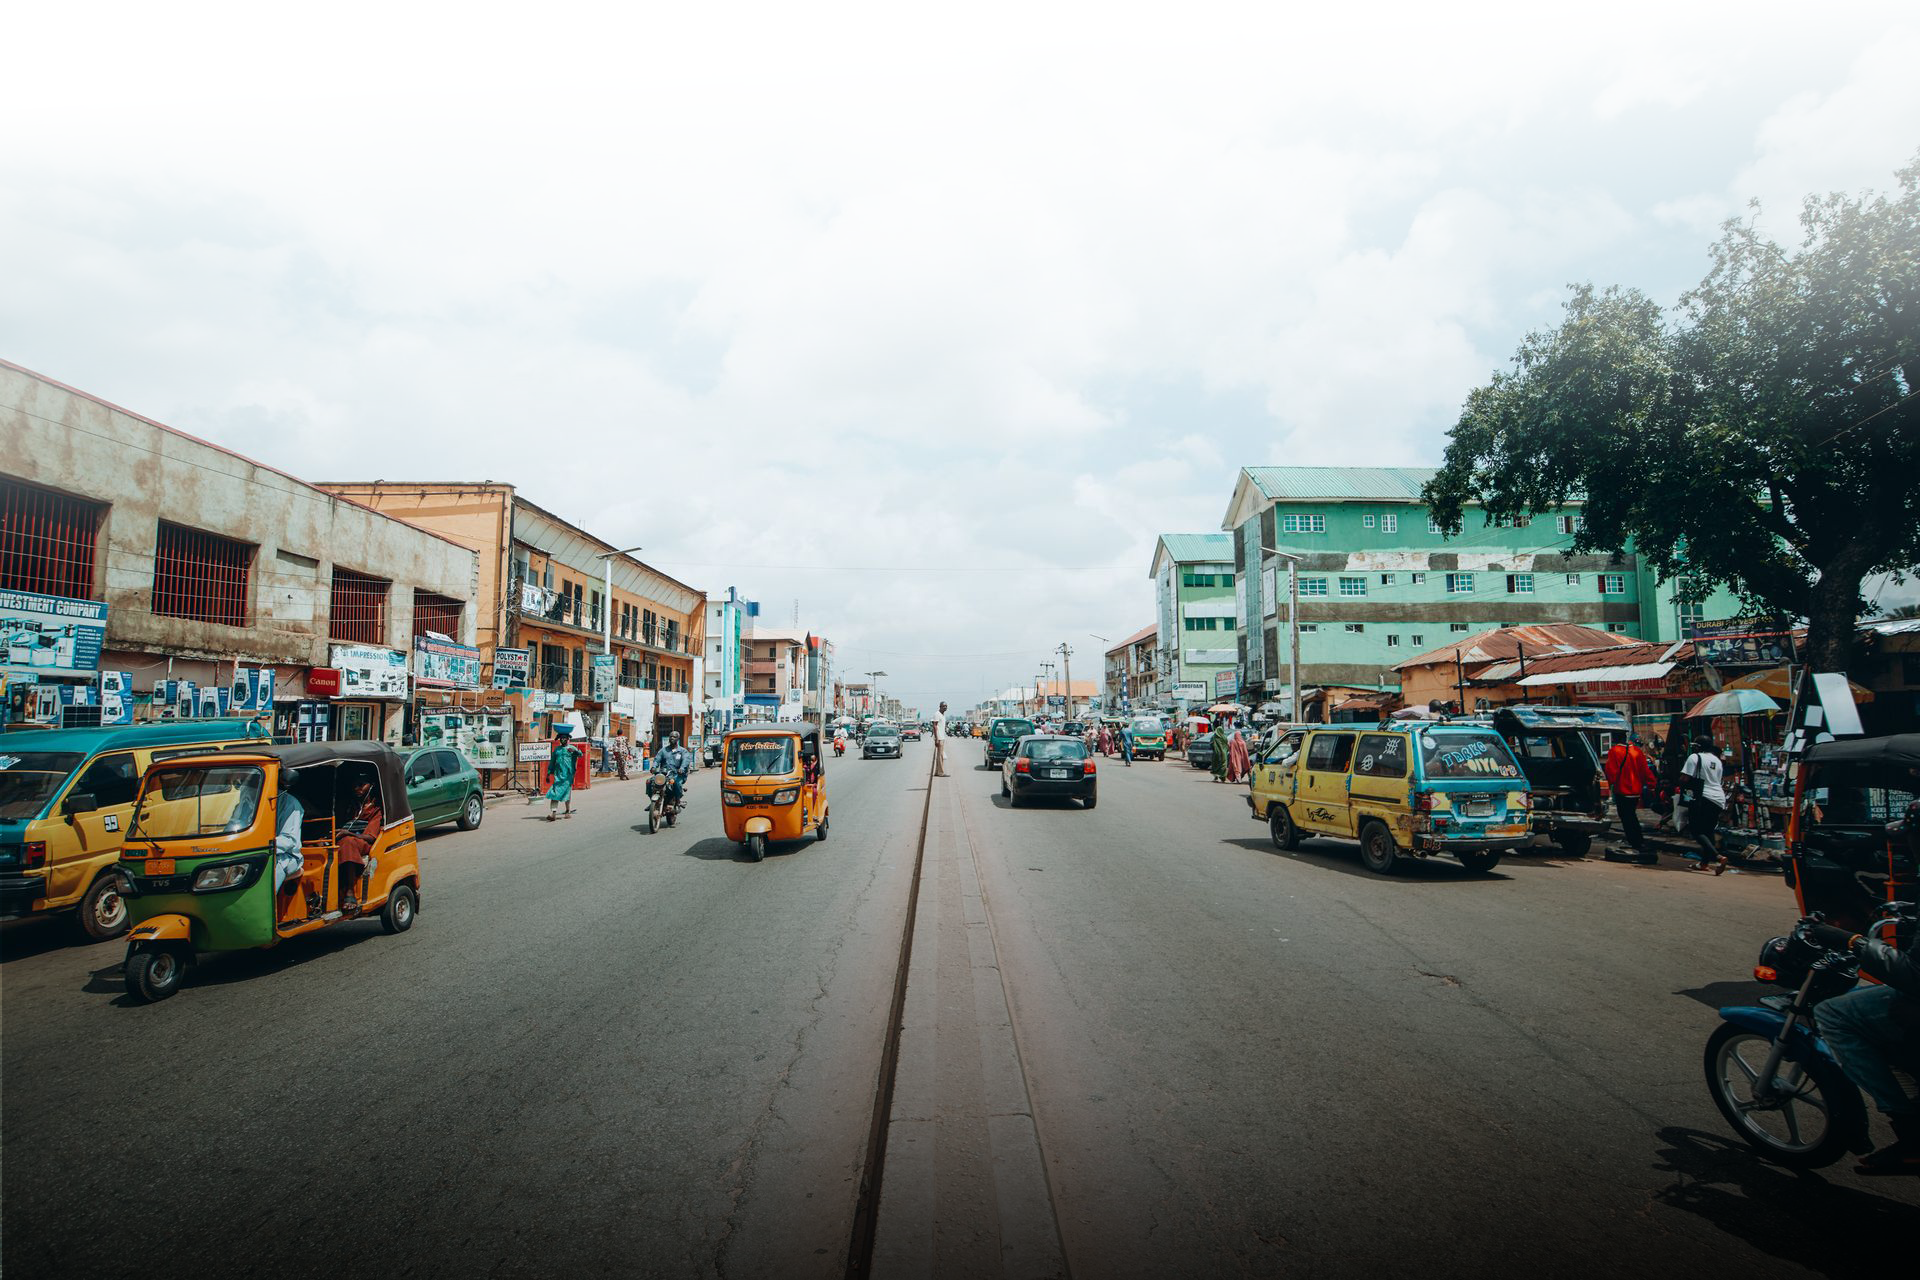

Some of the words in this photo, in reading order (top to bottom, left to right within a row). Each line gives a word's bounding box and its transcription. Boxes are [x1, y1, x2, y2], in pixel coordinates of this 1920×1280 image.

[56, 600, 102, 618] COMPANY
[350, 650, 389, 660] IMPRESSION
[309, 677, 336, 686] Canon
[521, 743, 550, 751] BOOKSHOP
